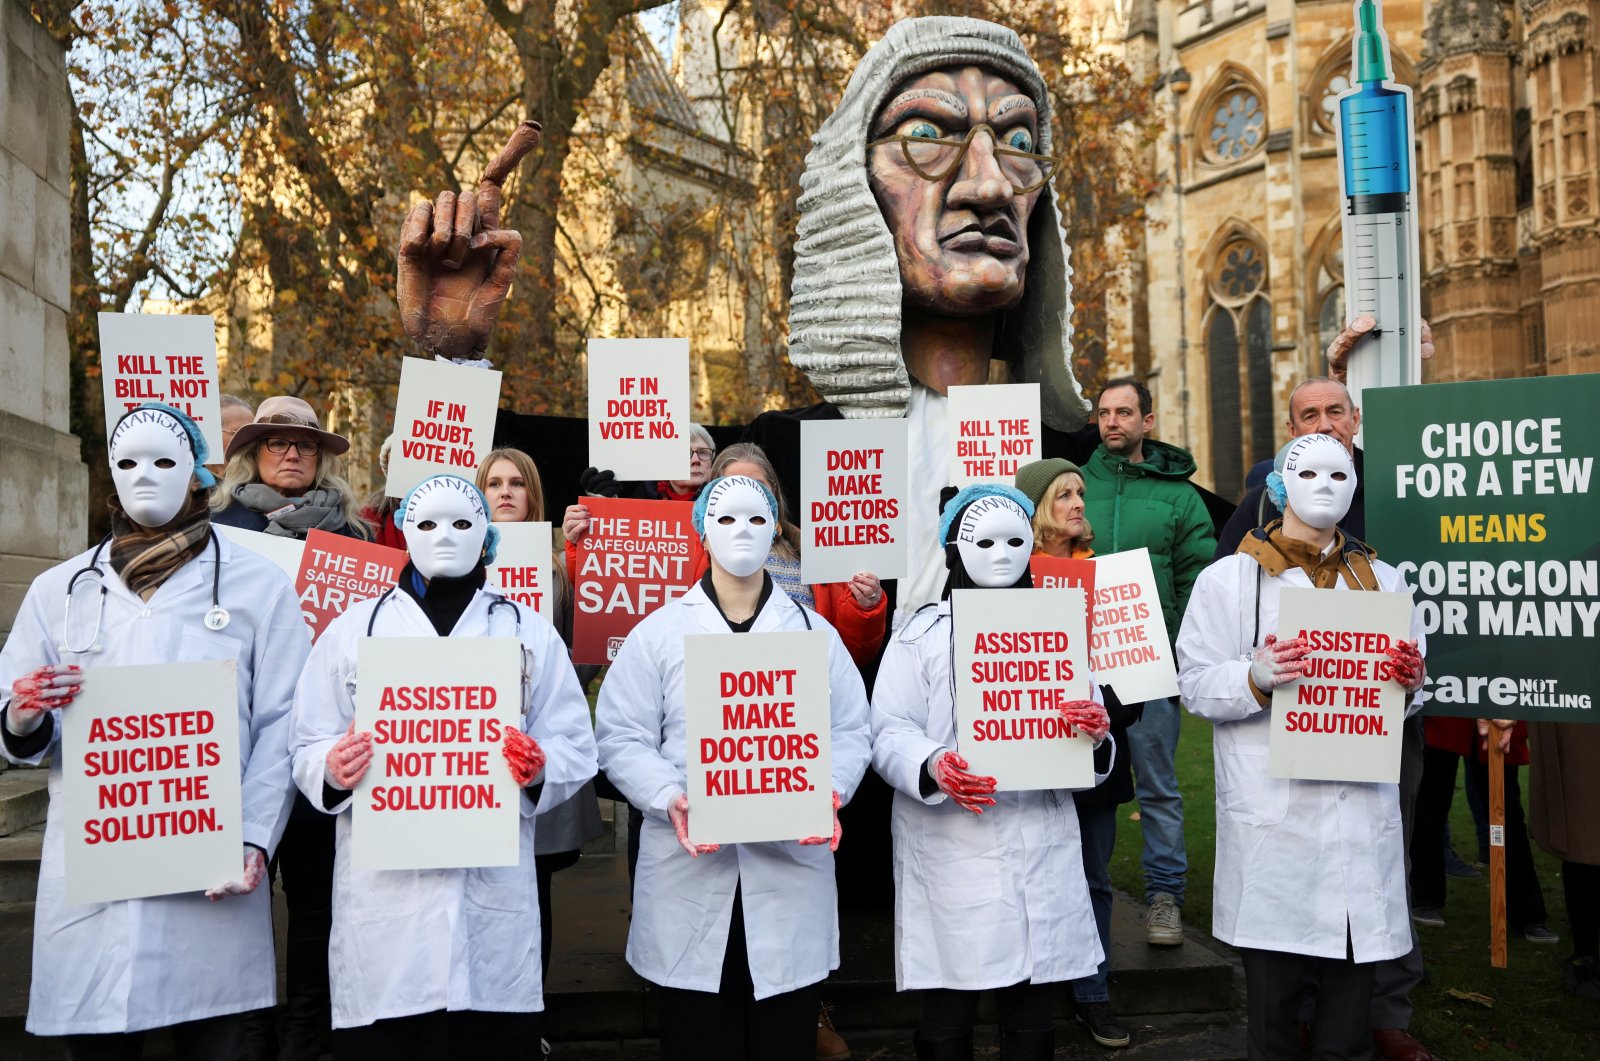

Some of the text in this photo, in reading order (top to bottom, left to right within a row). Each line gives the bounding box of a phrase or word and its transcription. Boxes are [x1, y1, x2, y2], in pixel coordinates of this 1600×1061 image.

[1393, 162, 1400, 171] 2
[1396, 217, 1402, 226] 3
[1397, 272, 1404, 281] 4
[1399, 327, 1405, 336] 5
[118, 355, 204, 375] KILL THE
[115, 379, 209, 400] BILL, NOT
[620, 377, 658, 396] IF IN
[428, 400, 466, 422] IF IN
[608, 399, 671, 420] DOUBT,
[412, 420, 473, 449] DOUBT,
[599, 421, 679, 440] VOTE NO.
[960, 419, 1029, 437] KILL THE
[1422, 418, 1561, 458] CHOICE
[402, 440, 478, 468] VOTE NO.
[827, 449, 884, 471] DON'T
[957, 439, 1034, 459] BILL, NOT
[963, 460, 994, 477] THE
[1397, 458, 1593, 498] FOR A FEW
[829, 474, 882, 496] MAKE
[406, 478, 484, 523] EUTHANISER
[811, 498, 899, 522] DOCTORS
[590, 518, 688, 539] THE BILL
[815, 524, 894, 547] KILLERS.
[1441, 514, 1546, 542] MEANS
[584, 539, 688, 554] SAFEGUARDS
[312, 549, 399, 585] THE BIL
[498, 567, 538, 588] THE
[581, 553, 689, 579] ARENT
[1397, 560, 1598, 596] COERCION
[1094, 583, 1142, 605] ISTED
[1092, 603, 1149, 628] CIDE IS
[1416, 600, 1600, 636] OR MANY
[975, 631, 1068, 654] ASSISTED
[1090, 625, 1147, 649] OT THE
[1298, 629, 1391, 653] ASSISTED
[1089, 645, 1160, 672] OLUTION.
[1302, 658, 1392, 682] UICIDE IS
[720, 669, 797, 698] DON'T
[972, 660, 1074, 683] SUICIDE IS
[1298, 685, 1381, 709] NOT THE
[1422, 676, 1518, 705] care
[1520, 679, 1557, 692] NOT
[379, 686, 496, 711] ASSISTED
[983, 688, 1065, 712] NOT THE
[1520, 693, 1591, 708] KILLING
[88, 710, 214, 743] ASSISTED
[723, 702, 796, 730] MAKE
[1286, 711, 1388, 736] SOLUTION.
[374, 718, 502, 744] SUICIDE IS
[973, 717, 1077, 741] SOLUTION.
[84, 742, 220, 777] SUICIDE IS
[700, 733, 819, 764] DOCTORS
[386, 751, 489, 777] NOT THE
[99, 776, 208, 809] NOT THE
[706, 765, 815, 796] KILLERS.
[371, 784, 501, 811] SOLUTION.
[84, 808, 223, 844] SOLUTION.
